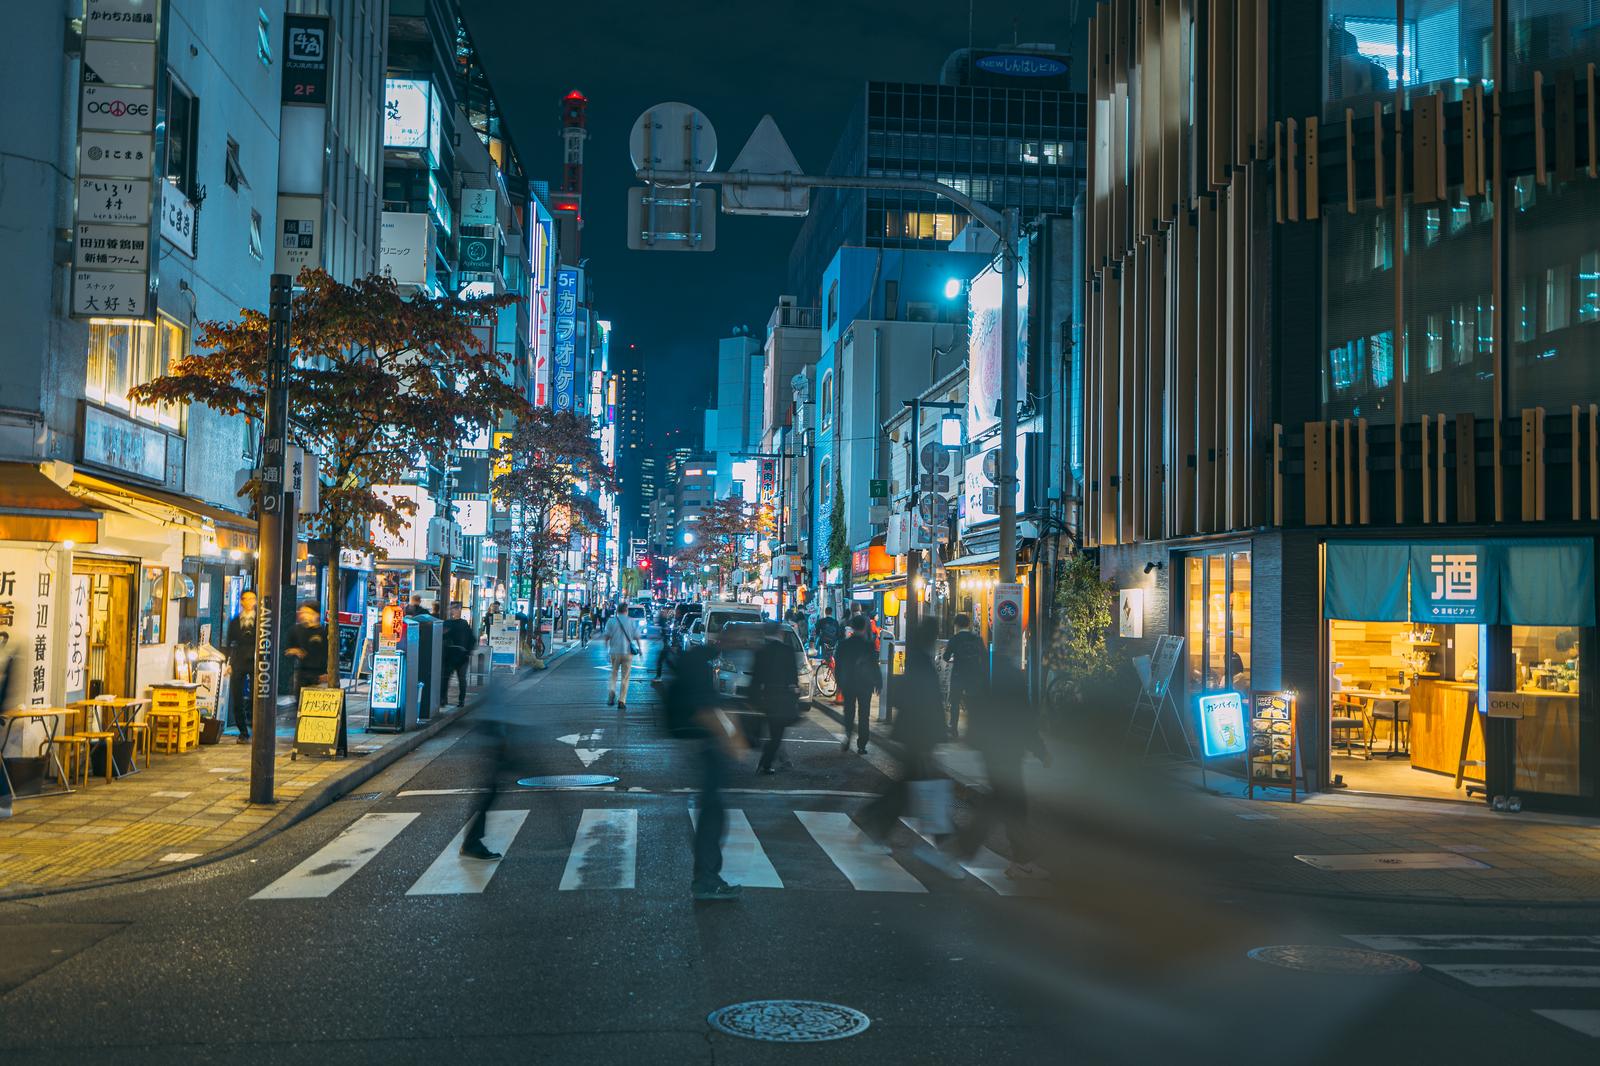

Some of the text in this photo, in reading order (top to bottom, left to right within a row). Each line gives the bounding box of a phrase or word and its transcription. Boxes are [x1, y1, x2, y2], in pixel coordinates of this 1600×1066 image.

[294, 34, 320, 54] 牛角
[85, 73, 97, 81] 5F
[294, 84, 315, 95] 2F
[105, 198, 122, 210] 村
[84, 253, 139, 264] 新橋ファーム
[559, 274, 575, 287] 5F
[84, 295, 137, 312] 大好き
[554, 289, 576, 416] カラオケの
[263, 438, 280, 511] 柳通り
[763, 461, 773, 505] 焼肉ホル
[1431, 555, 1477, 600] 酒
[72, 580, 86, 687] からあげ
[1491, 700, 1520, 709] OPEN
